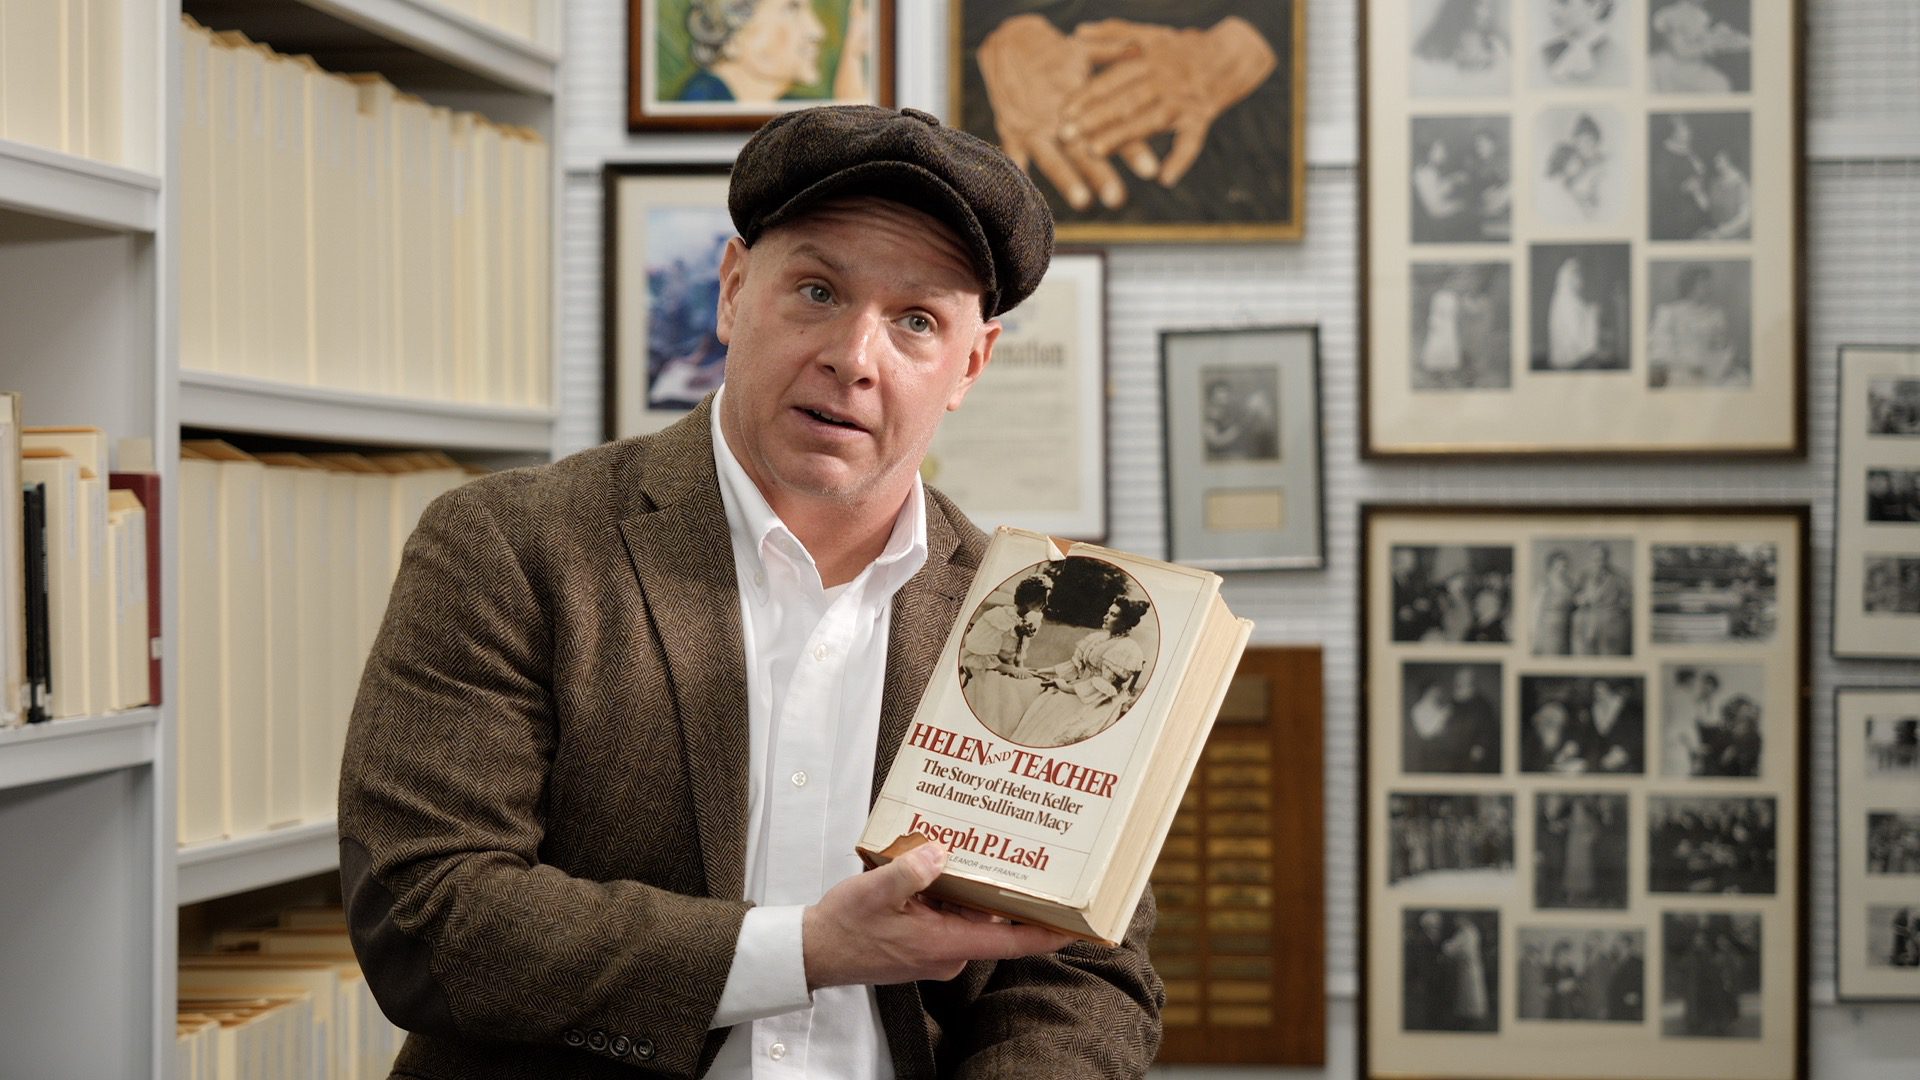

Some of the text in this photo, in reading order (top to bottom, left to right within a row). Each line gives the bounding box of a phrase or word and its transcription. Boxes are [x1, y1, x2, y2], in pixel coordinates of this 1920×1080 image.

[907, 722, 1118, 798] HELEN AND TEACHER
[922, 758, 1083, 815] The Story of Helen Keller
[916, 779, 1073, 835] and Anne Sullivan Macy
[908, 813, 1050, 871] Joseph P. Lash
[979, 864, 993, 872] and
[993, 866, 1029, 881] FRANKLIN
